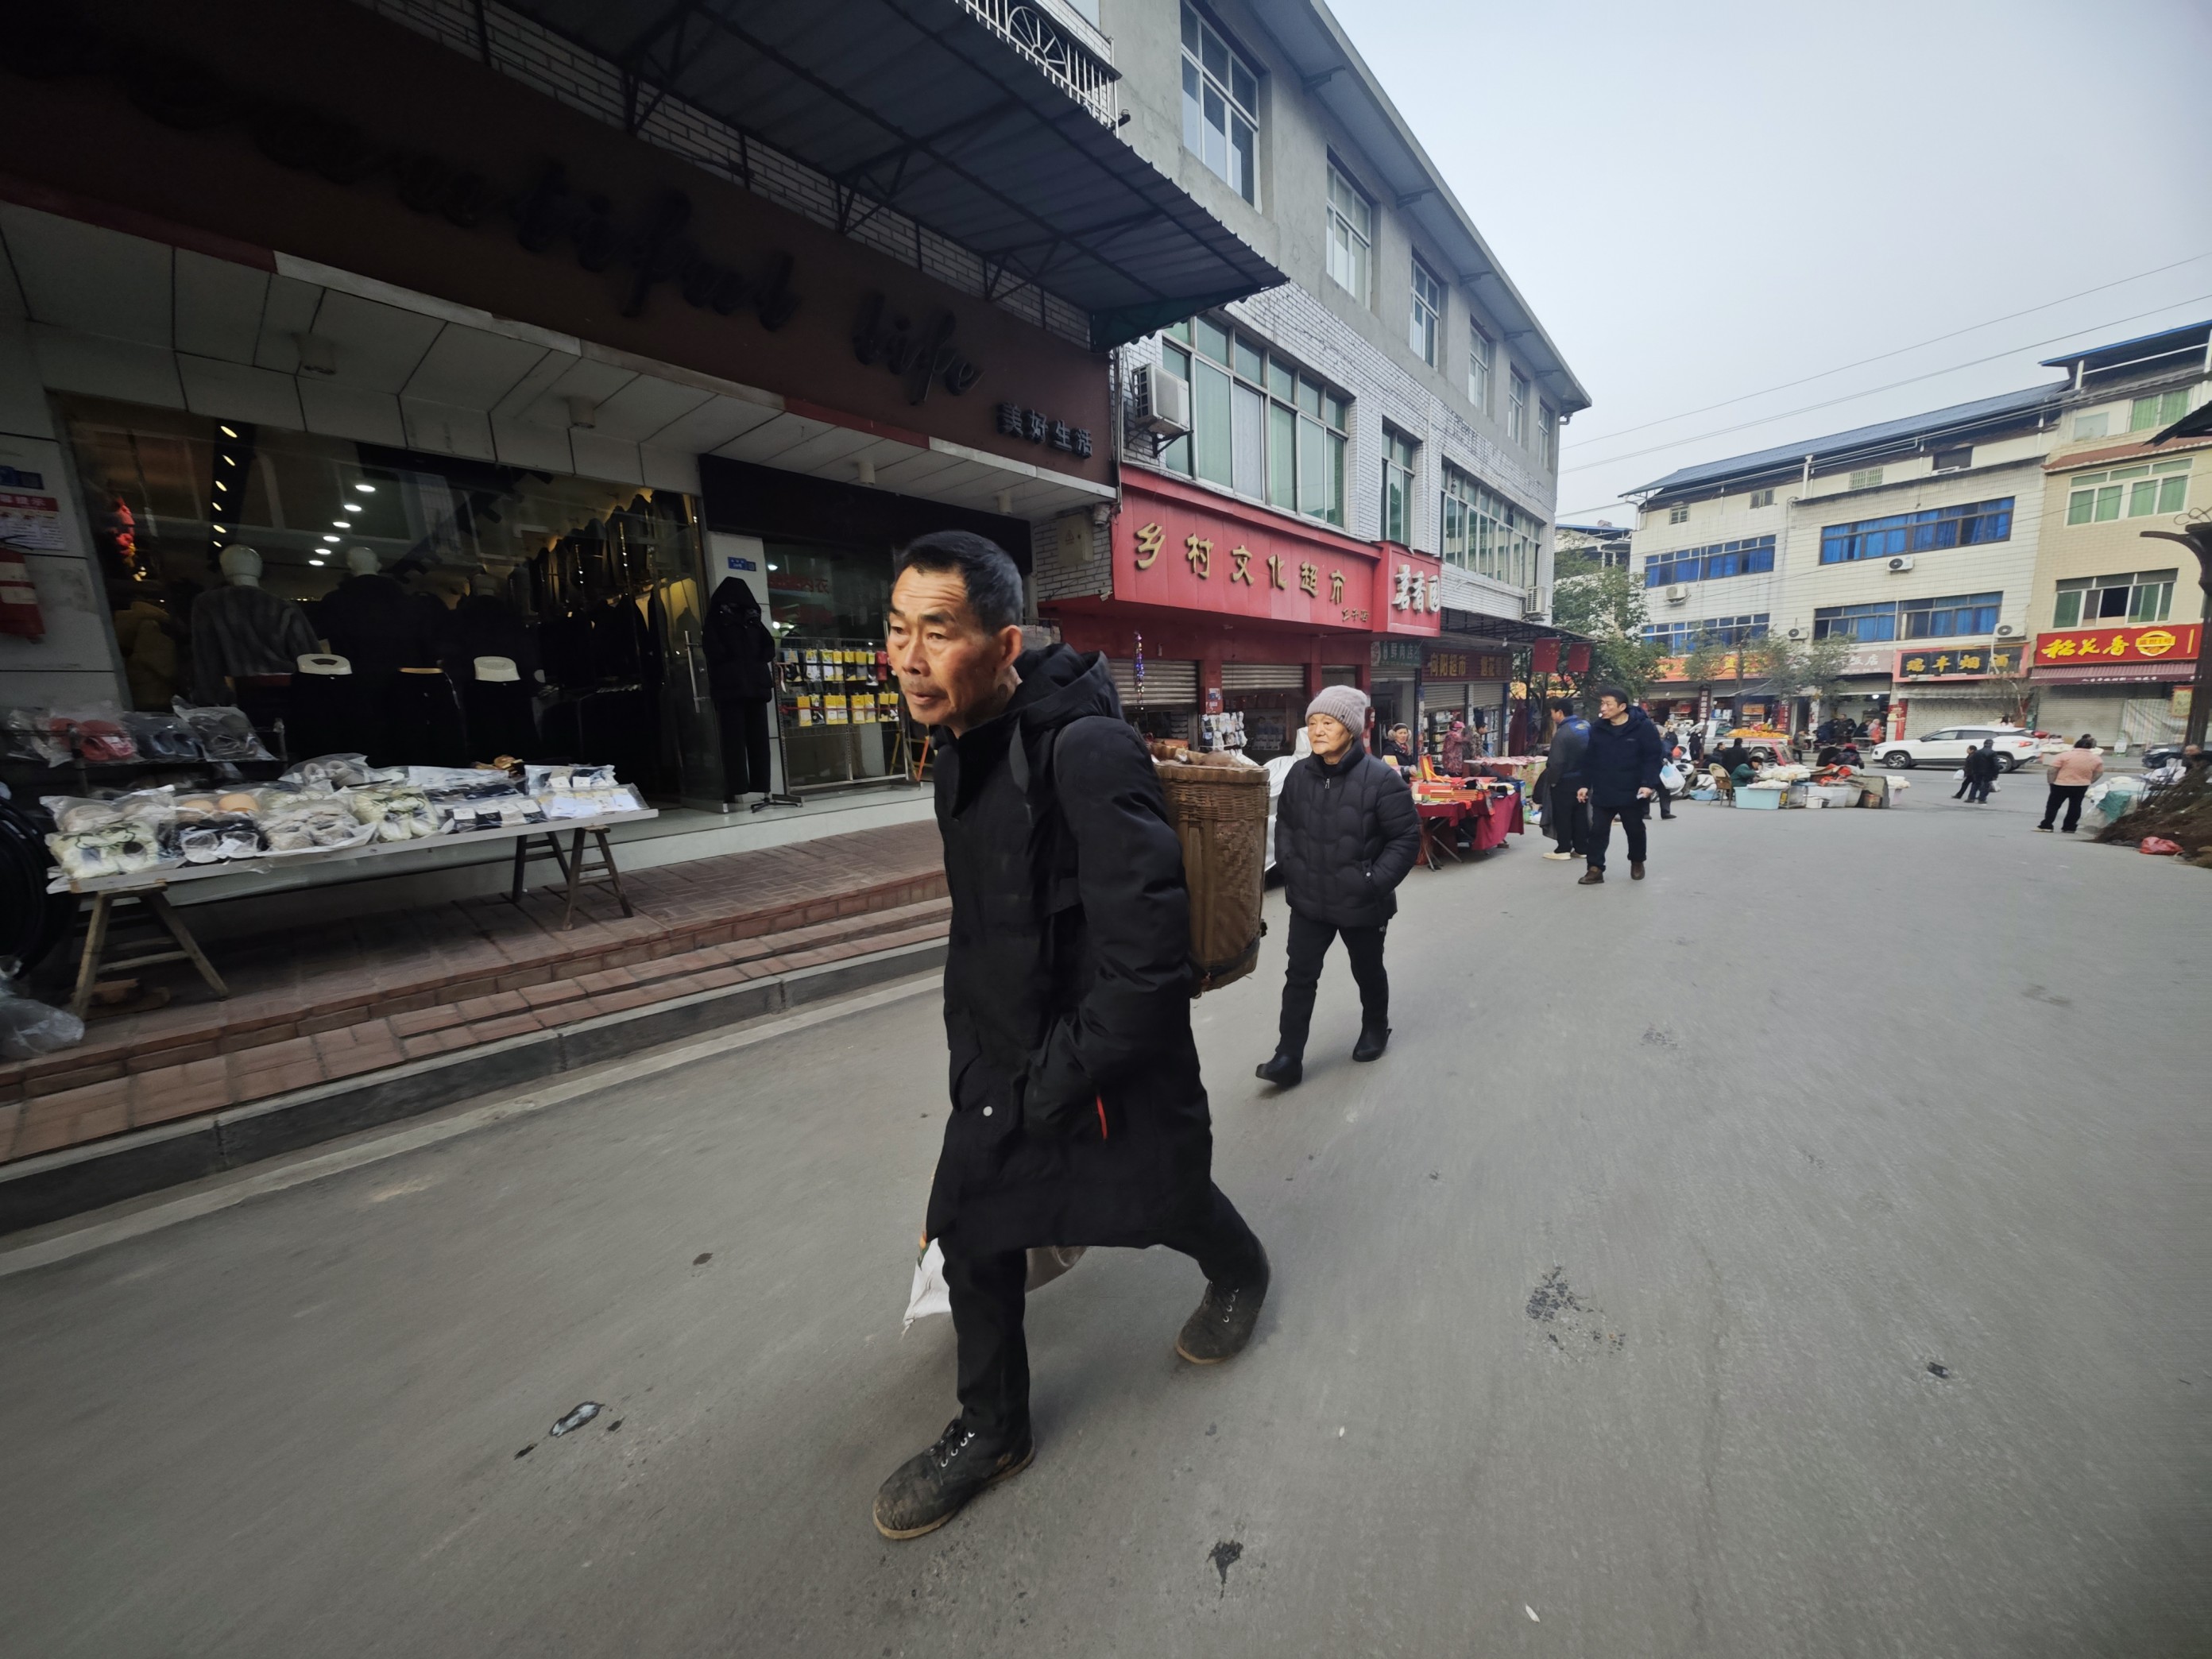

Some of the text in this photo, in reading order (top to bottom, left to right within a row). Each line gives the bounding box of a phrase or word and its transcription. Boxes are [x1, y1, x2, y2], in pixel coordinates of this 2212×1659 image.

[998, 400, 1093, 458] 美好生活
[1135, 522, 1347, 605] 乡村文化超市
[1430, 652, 1467, 677] 向阳超市
[2041, 635, 2129, 659] 稻花香
